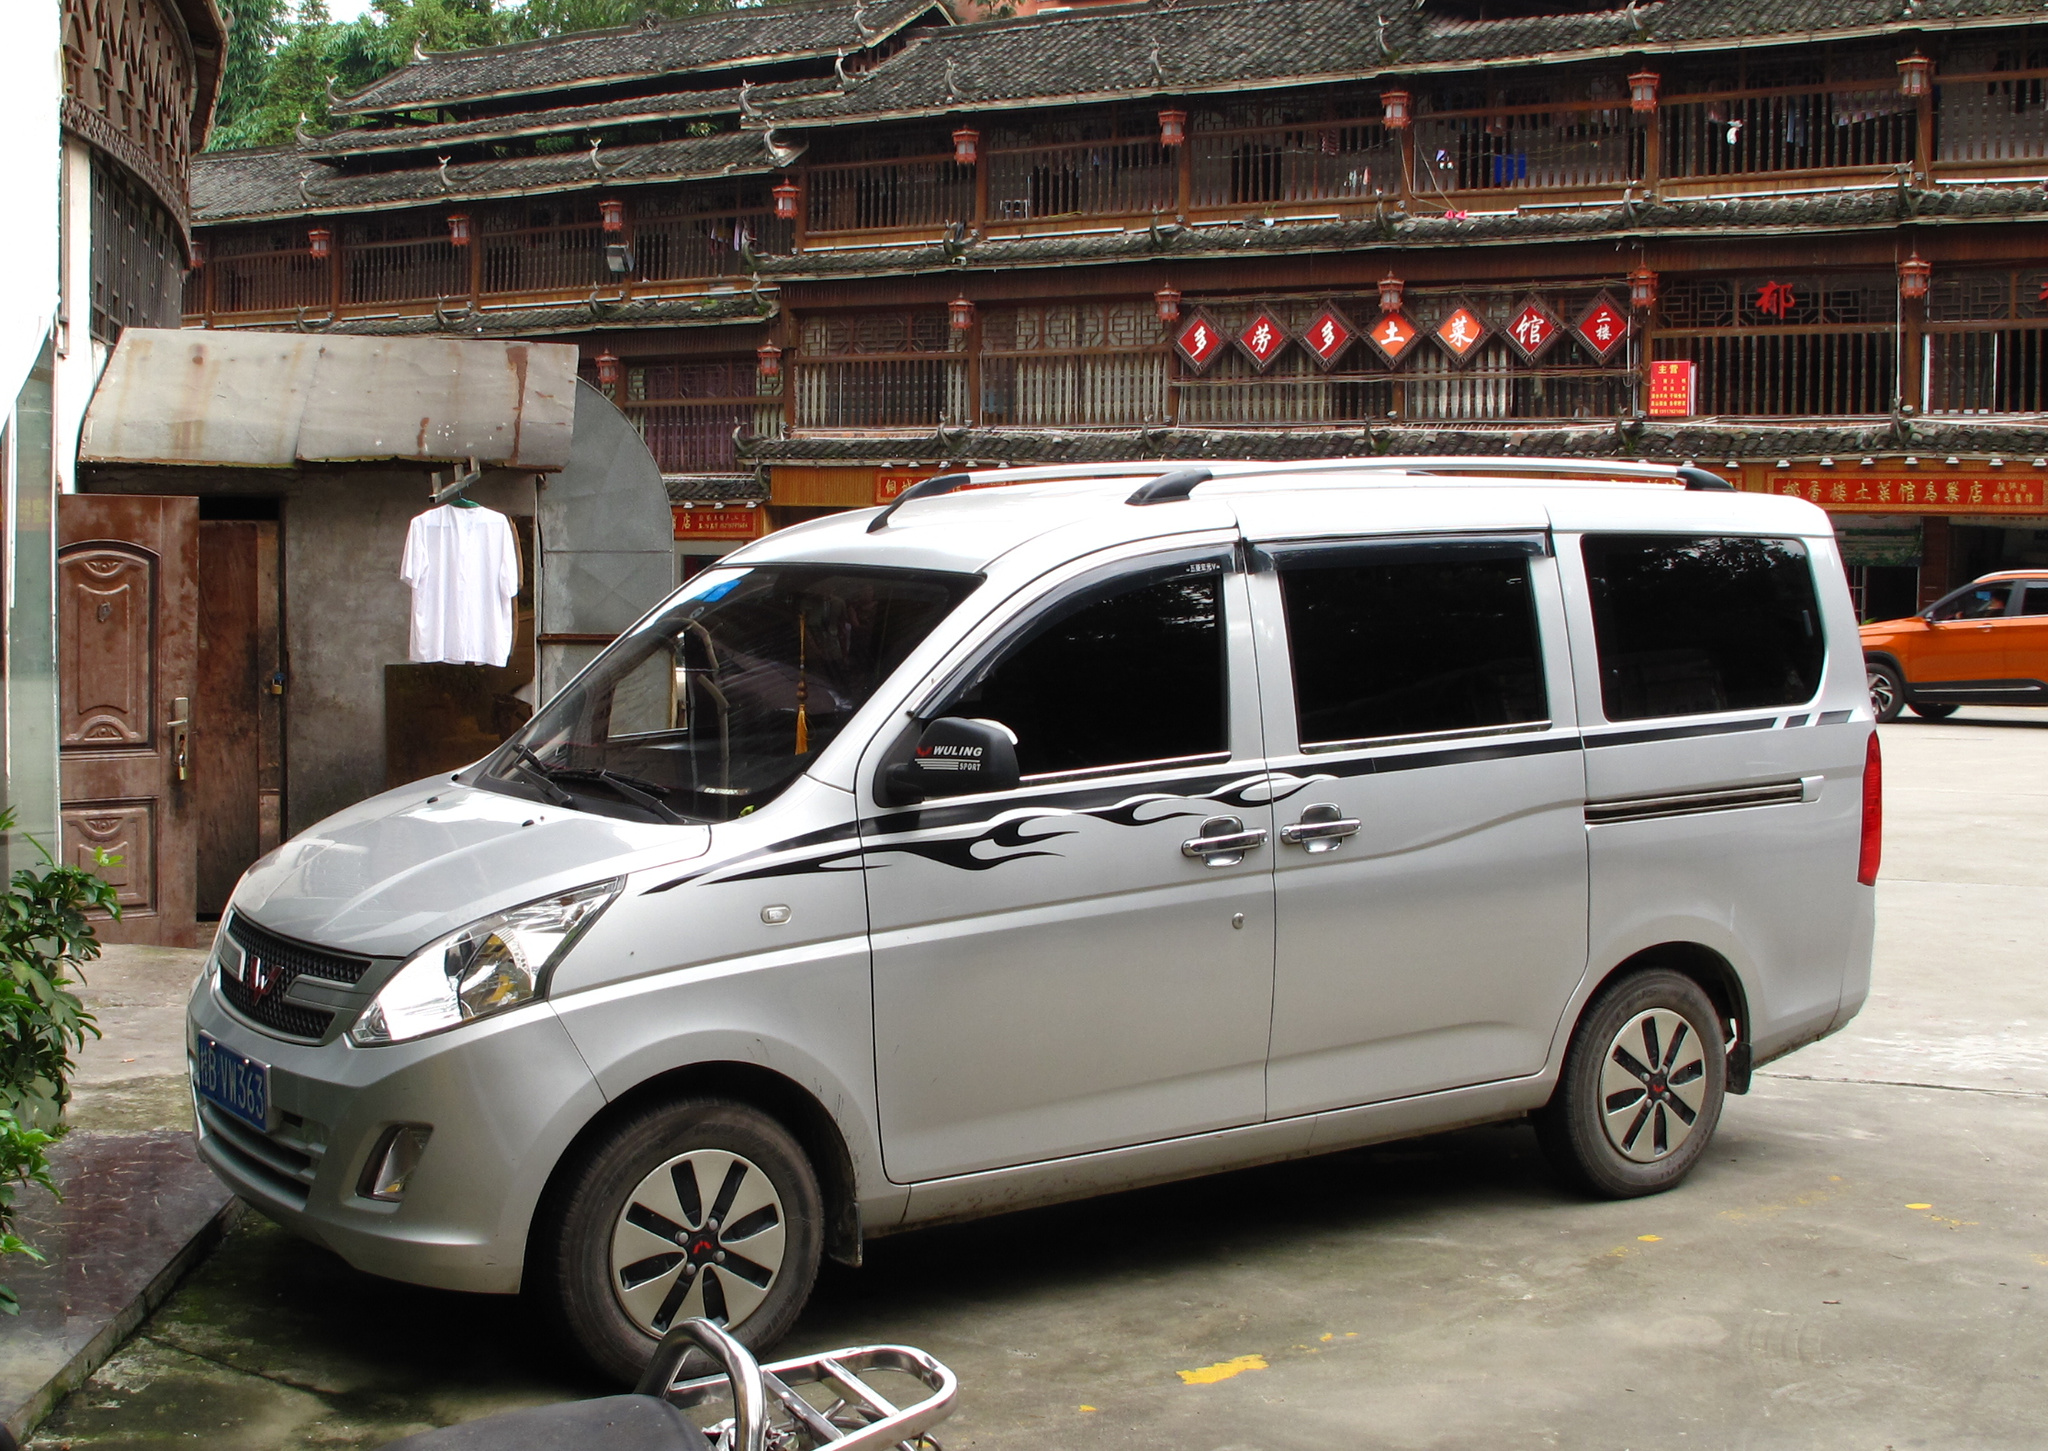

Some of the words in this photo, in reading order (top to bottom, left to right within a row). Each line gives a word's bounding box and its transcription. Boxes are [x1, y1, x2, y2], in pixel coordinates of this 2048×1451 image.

[1595, 311, 1612, 341] 二楼
[933, 745, 983, 757] WULING
[959, 762, 981, 771] SPORT
